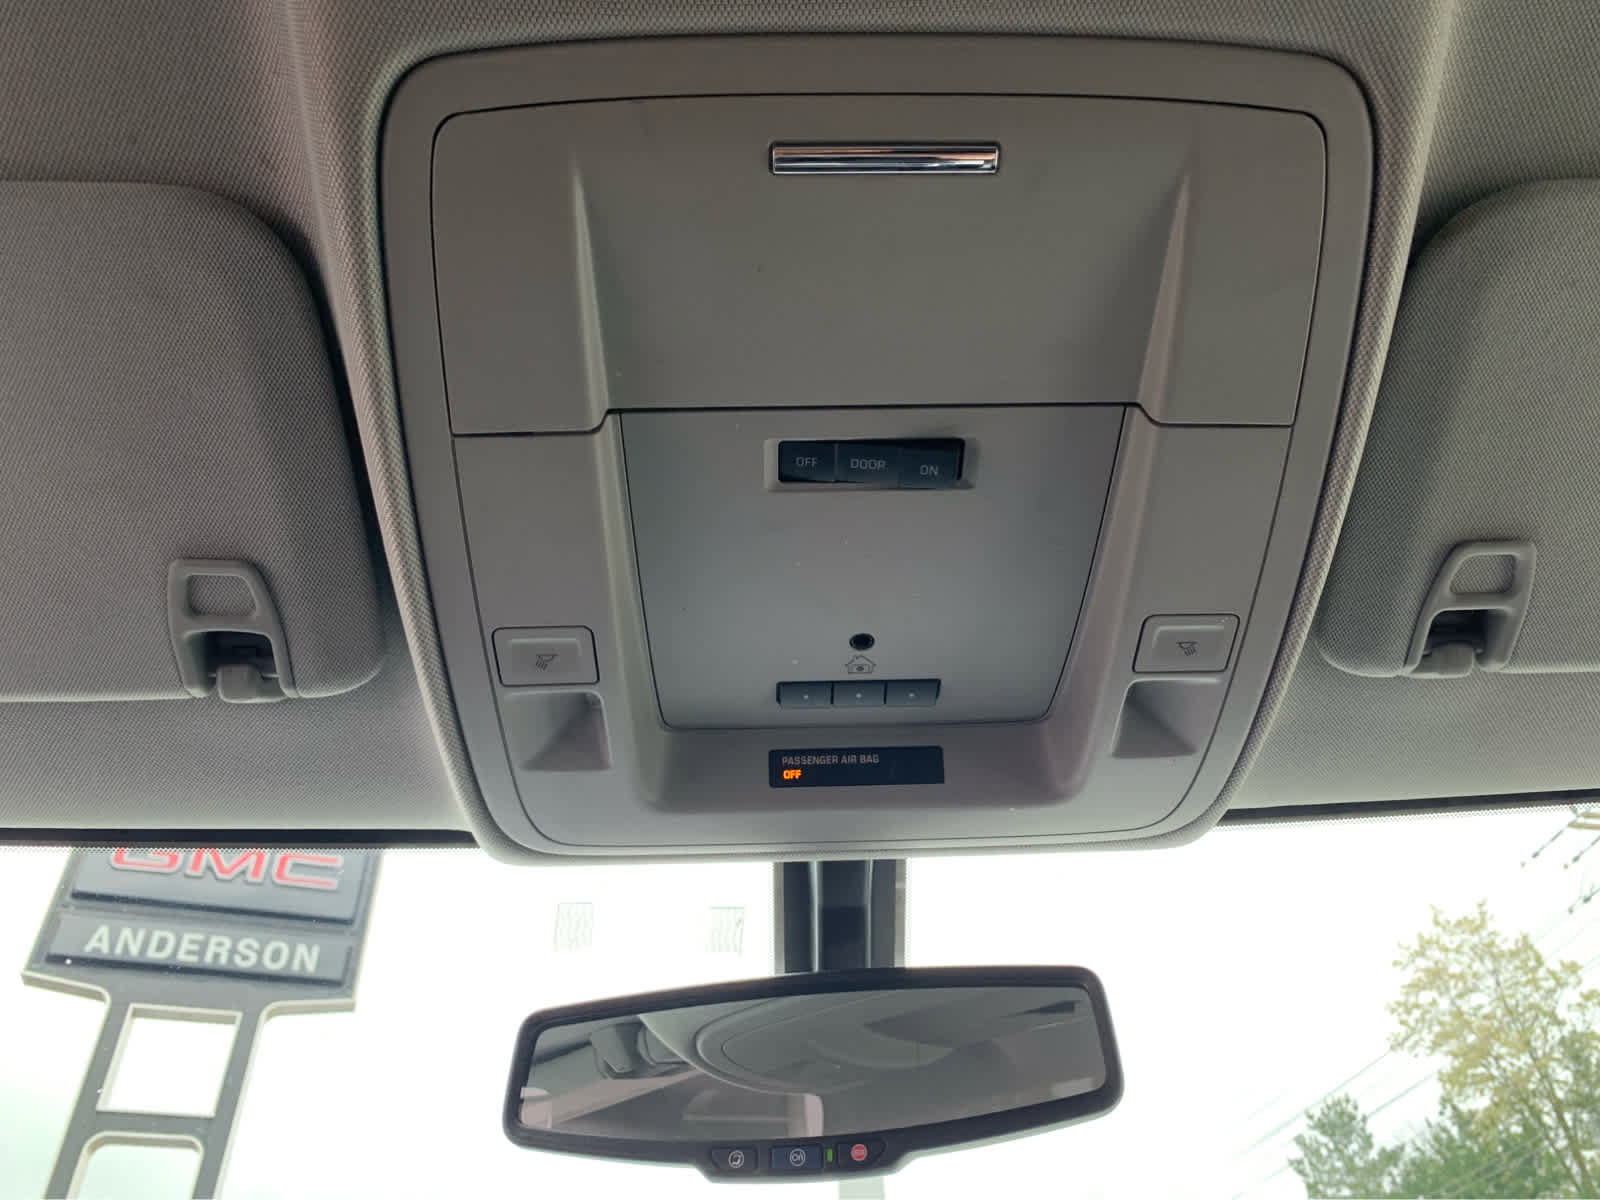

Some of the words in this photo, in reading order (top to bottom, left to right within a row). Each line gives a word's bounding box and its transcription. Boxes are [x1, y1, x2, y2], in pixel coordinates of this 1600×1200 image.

[796, 456, 818, 467] OFF
[850, 458, 886, 470] DOOR
[919, 464, 939, 476] ON
[782, 755, 838, 766] PASSENGER
[841, 754, 857, 765] AIR
[860, 753, 880, 764] BAG
[783, 769, 802, 780] OFF
[110, 848, 344, 890] GMC
[85, 925, 320, 974] ANDERSON
